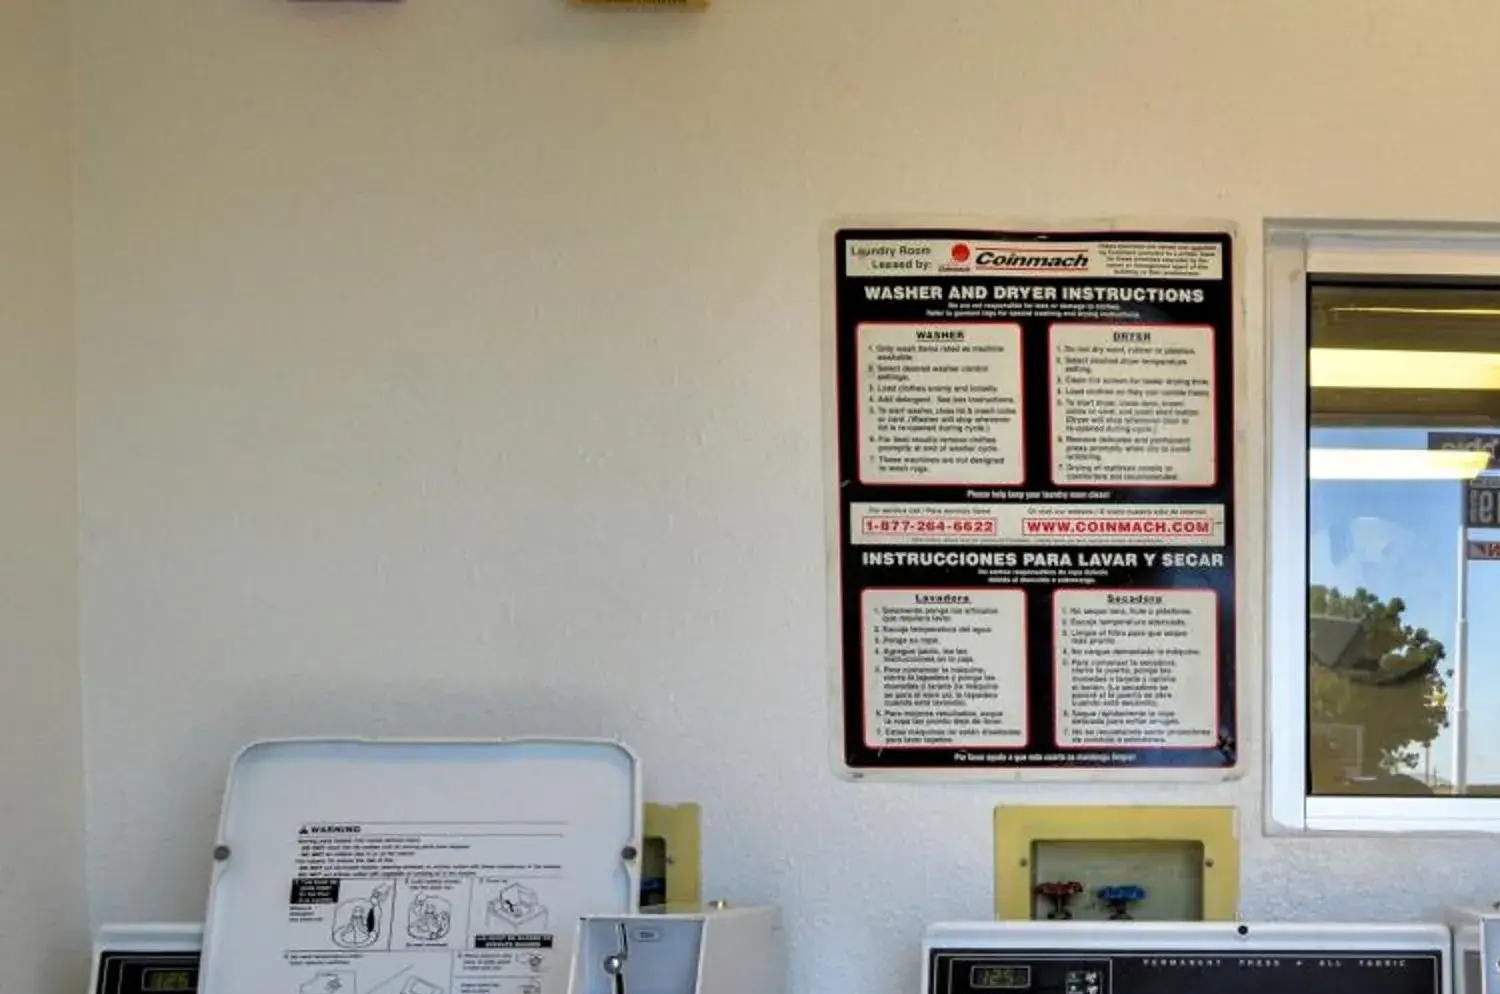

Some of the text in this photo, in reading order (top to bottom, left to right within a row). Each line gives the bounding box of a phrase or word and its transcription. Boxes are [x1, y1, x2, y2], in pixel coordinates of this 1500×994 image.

[851, 244, 931, 257] Laundry Room
[872, 259, 912, 270] Leased
[976, 251, 1089, 267] Coinmach
[864, 285, 1204, 303] WASHER AND DRYER INSTRUCTIONS
[916, 331, 964, 340] WASHER
[1113, 332, 1151, 342] DRYER
[866, 521, 993, 533] 1-877-264-6622
[1026, 521, 1209, 533] WWW.COINMACH.COM
[862, 552, 1223, 567] INSTRUCCIONES PARA LAVAR Y SECAR
[311, 825, 362, 834] WARNING
